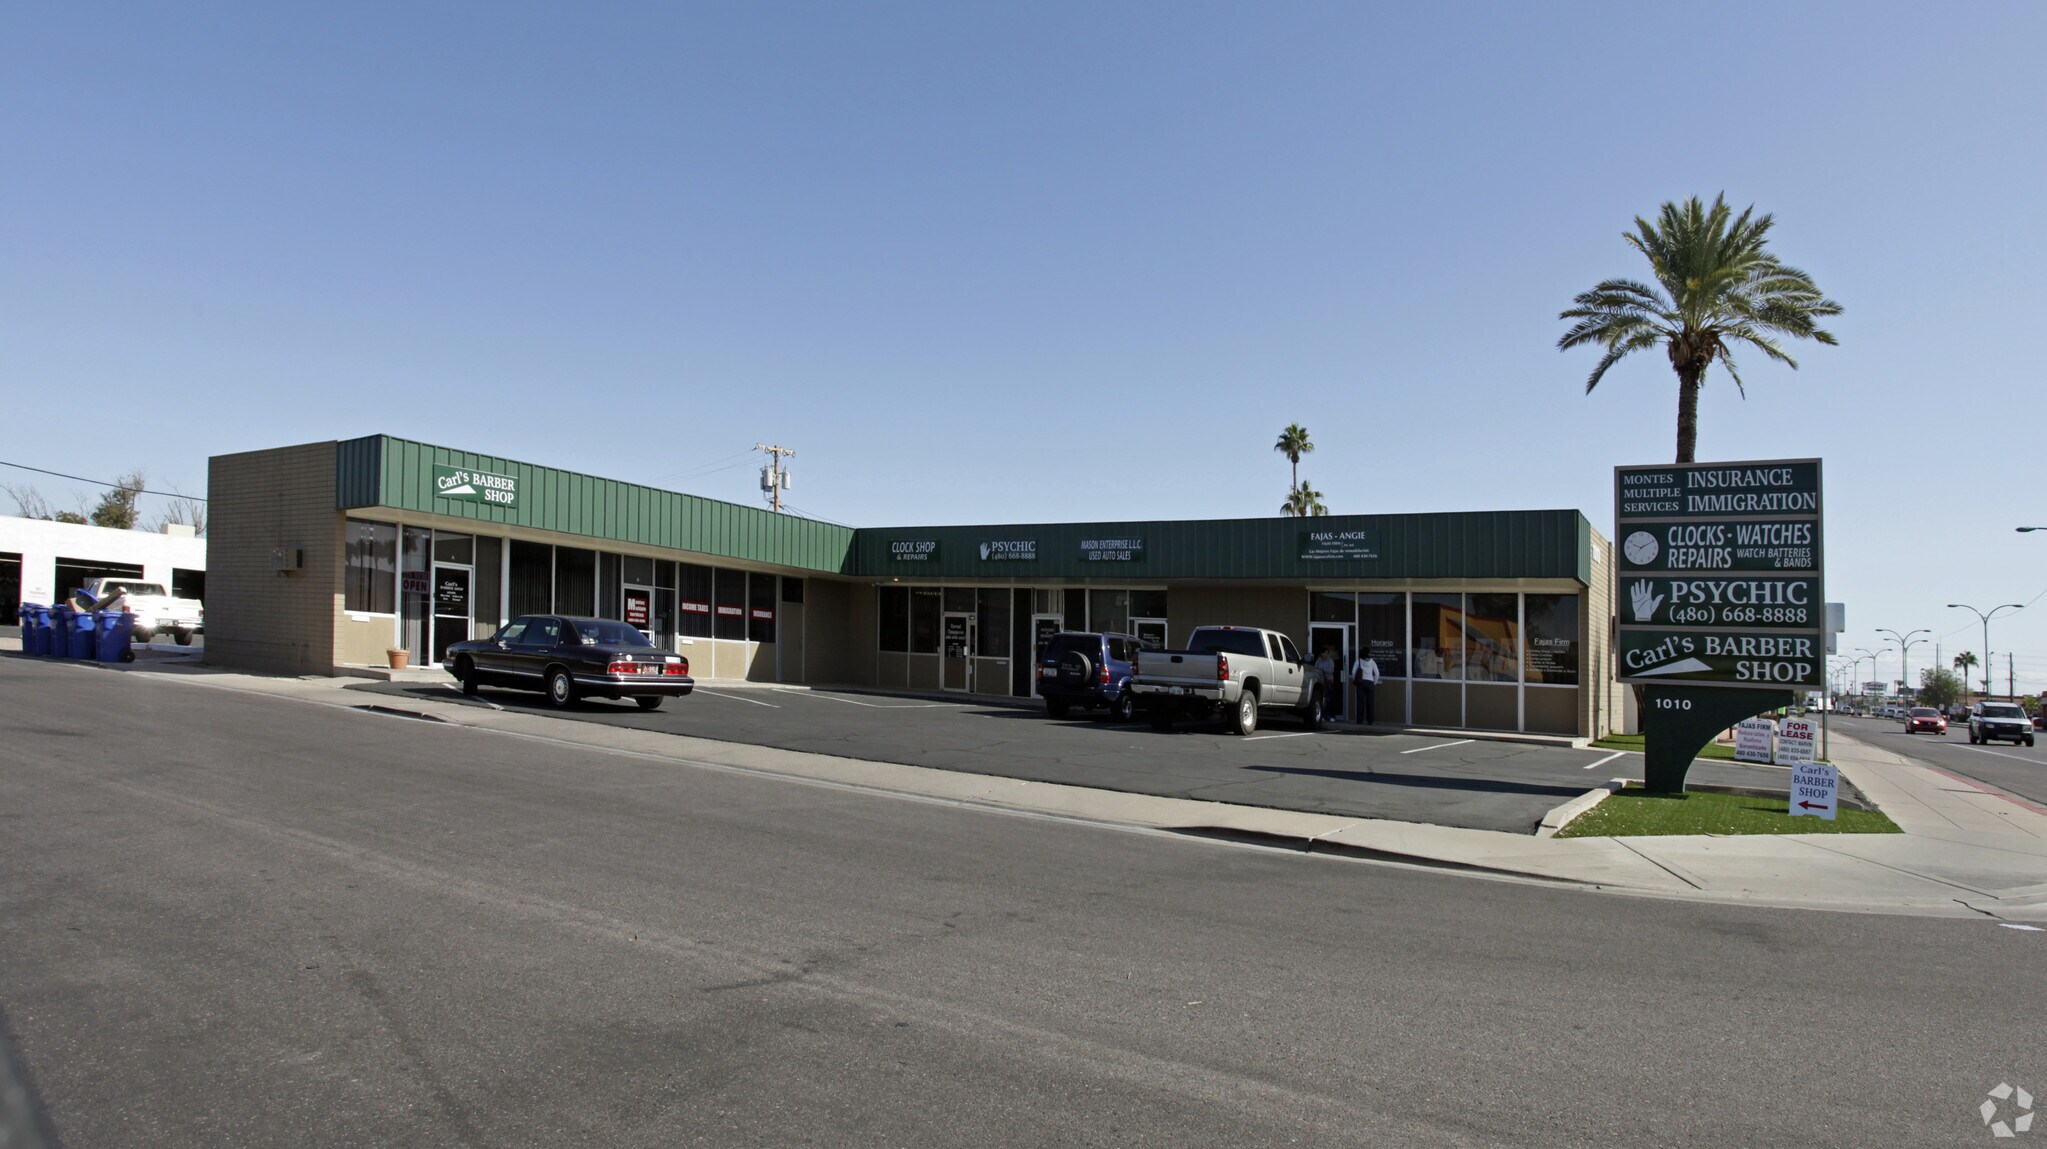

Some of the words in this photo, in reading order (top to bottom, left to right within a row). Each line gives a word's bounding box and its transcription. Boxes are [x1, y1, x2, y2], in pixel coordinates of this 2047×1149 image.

[438, 471, 469, 489] Carl's
[472, 473, 515, 491] BARBER
[1624, 474, 1674, 485] MONTES
[1687, 469, 1793, 488] INSURANCE
[484, 489, 514, 504] SHOP
[1624, 488, 1681, 498] MULTIPLE
[1624, 501, 1679, 512] SERVICES
[1687, 492, 1816, 512] IMMIGRATION
[1311, 532, 1333, 541] FAJAS
[1339, 531, 1366, 540] ANGIE
[1668, 525, 1725, 546] CLOCKS
[1736, 524, 1812, 545] WATCHES
[892, 541, 914, 552] CLOCK
[916, 541, 936, 552] SHOP
[992, 541, 1036, 552] PSYCHIC
[1081, 540, 1098, 549] MASON
[1100, 539, 1128, 549] ENTERPRISE
[992, 552, 1008, 560] (480)
[1008, 552, 1036, 560] 668-8888
[1088, 551, 1101, 560] USED
[1102, 551, 1116, 560] AUTO
[1116, 550, 1131, 560] SALES
[1668, 548, 1732, 569] REPAIRS
[1737, 548, 1766, 558] WATCH
[1768, 548, 1811, 558] BATTERIES
[1775, 558, 1782, 568] &
[1783, 558, 1812, 568] BANDS
[403, 580, 426, 592] OPEN
[1670, 581, 1808, 605] PSYCHIC
[1669, 606, 1716, 624] (480)
[1722, 607, 1808, 623] 668-8888
[1534, 638, 1552, 646] Fajas
[1554, 638, 1570, 646] Firm
[1626, 636, 1695, 669] Carl's
[1705, 636, 1815, 658] BARBER
[1736, 662, 1812, 682] SHOP
[1656, 698, 1692, 710] 1010
[1786, 722, 1808, 731] FOR
[1780, 730, 1814, 740] LEASE
[1800, 766, 1830, 776] Carl's
[1793, 774, 1835, 788] BARBER
[1798, 786, 1828, 798] SHOP
